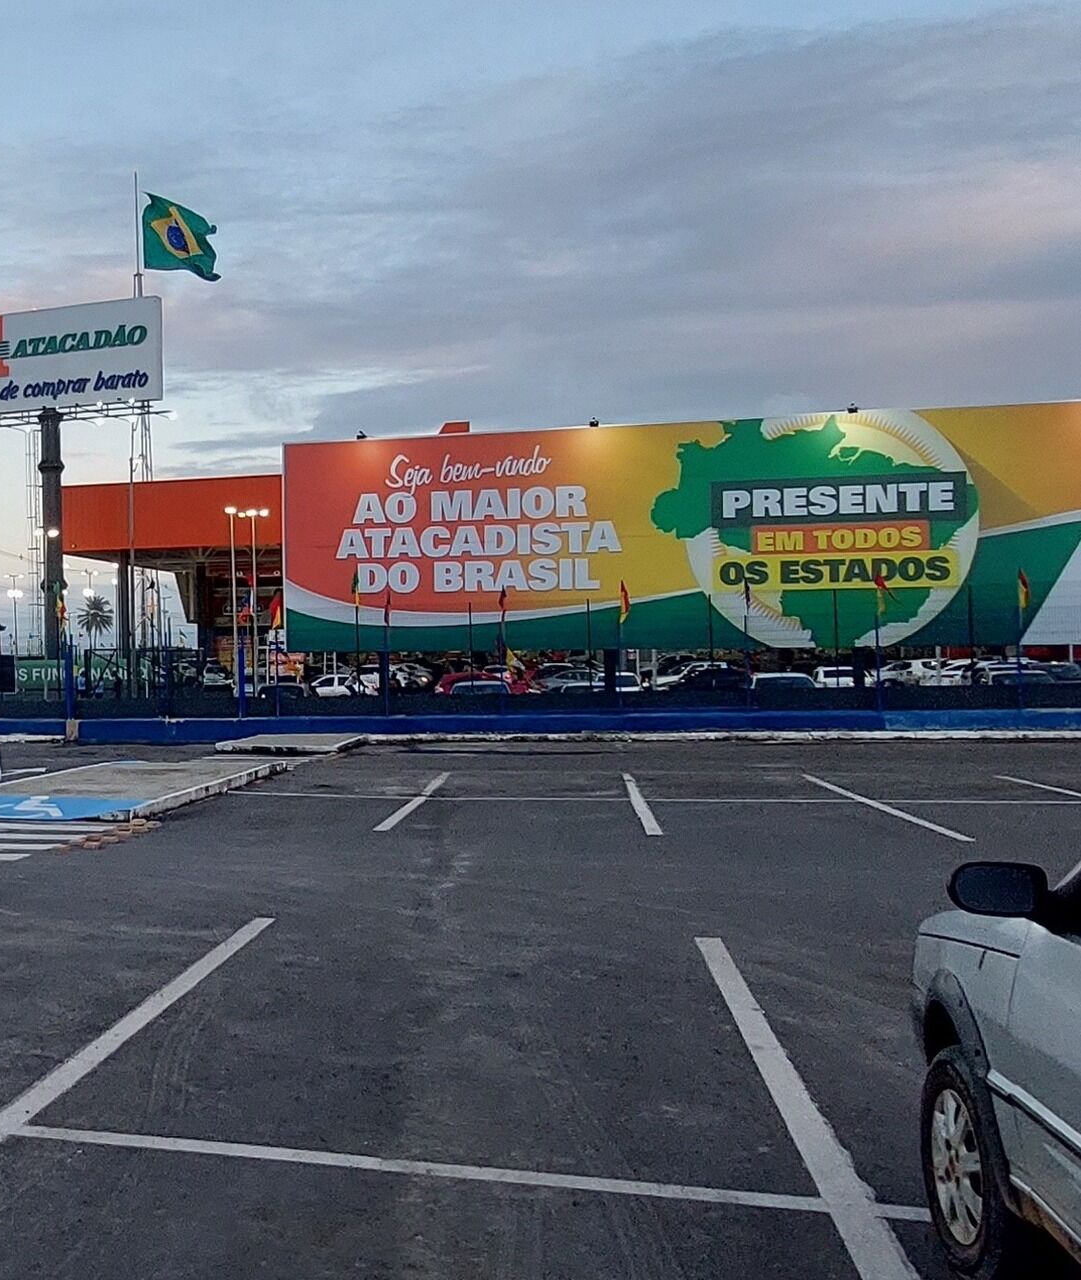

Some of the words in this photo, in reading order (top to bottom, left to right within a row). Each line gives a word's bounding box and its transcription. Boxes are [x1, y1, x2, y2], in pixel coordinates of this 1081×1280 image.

[0, 380, 19, 401] de
[23, 378, 91, 400] comprar
[93, 369, 149, 391] barato
[384, 454, 433, 496] Seja
[439, 445, 552, 483] bem-vindo
[352, 493, 417, 525] AO
[430, 485, 589, 522] MAIOR
[721, 481, 955, 519] PRESENTE
[335, 520, 623, 560] ATACADISTA
[756, 531, 804, 552] EM
[813, 526, 923, 550] TODOS
[356, 561, 420, 594] DO
[433, 558, 600, 593] BRASIL
[719, 560, 769, 586] OS
[779, 556, 952, 584] ESTADOS
